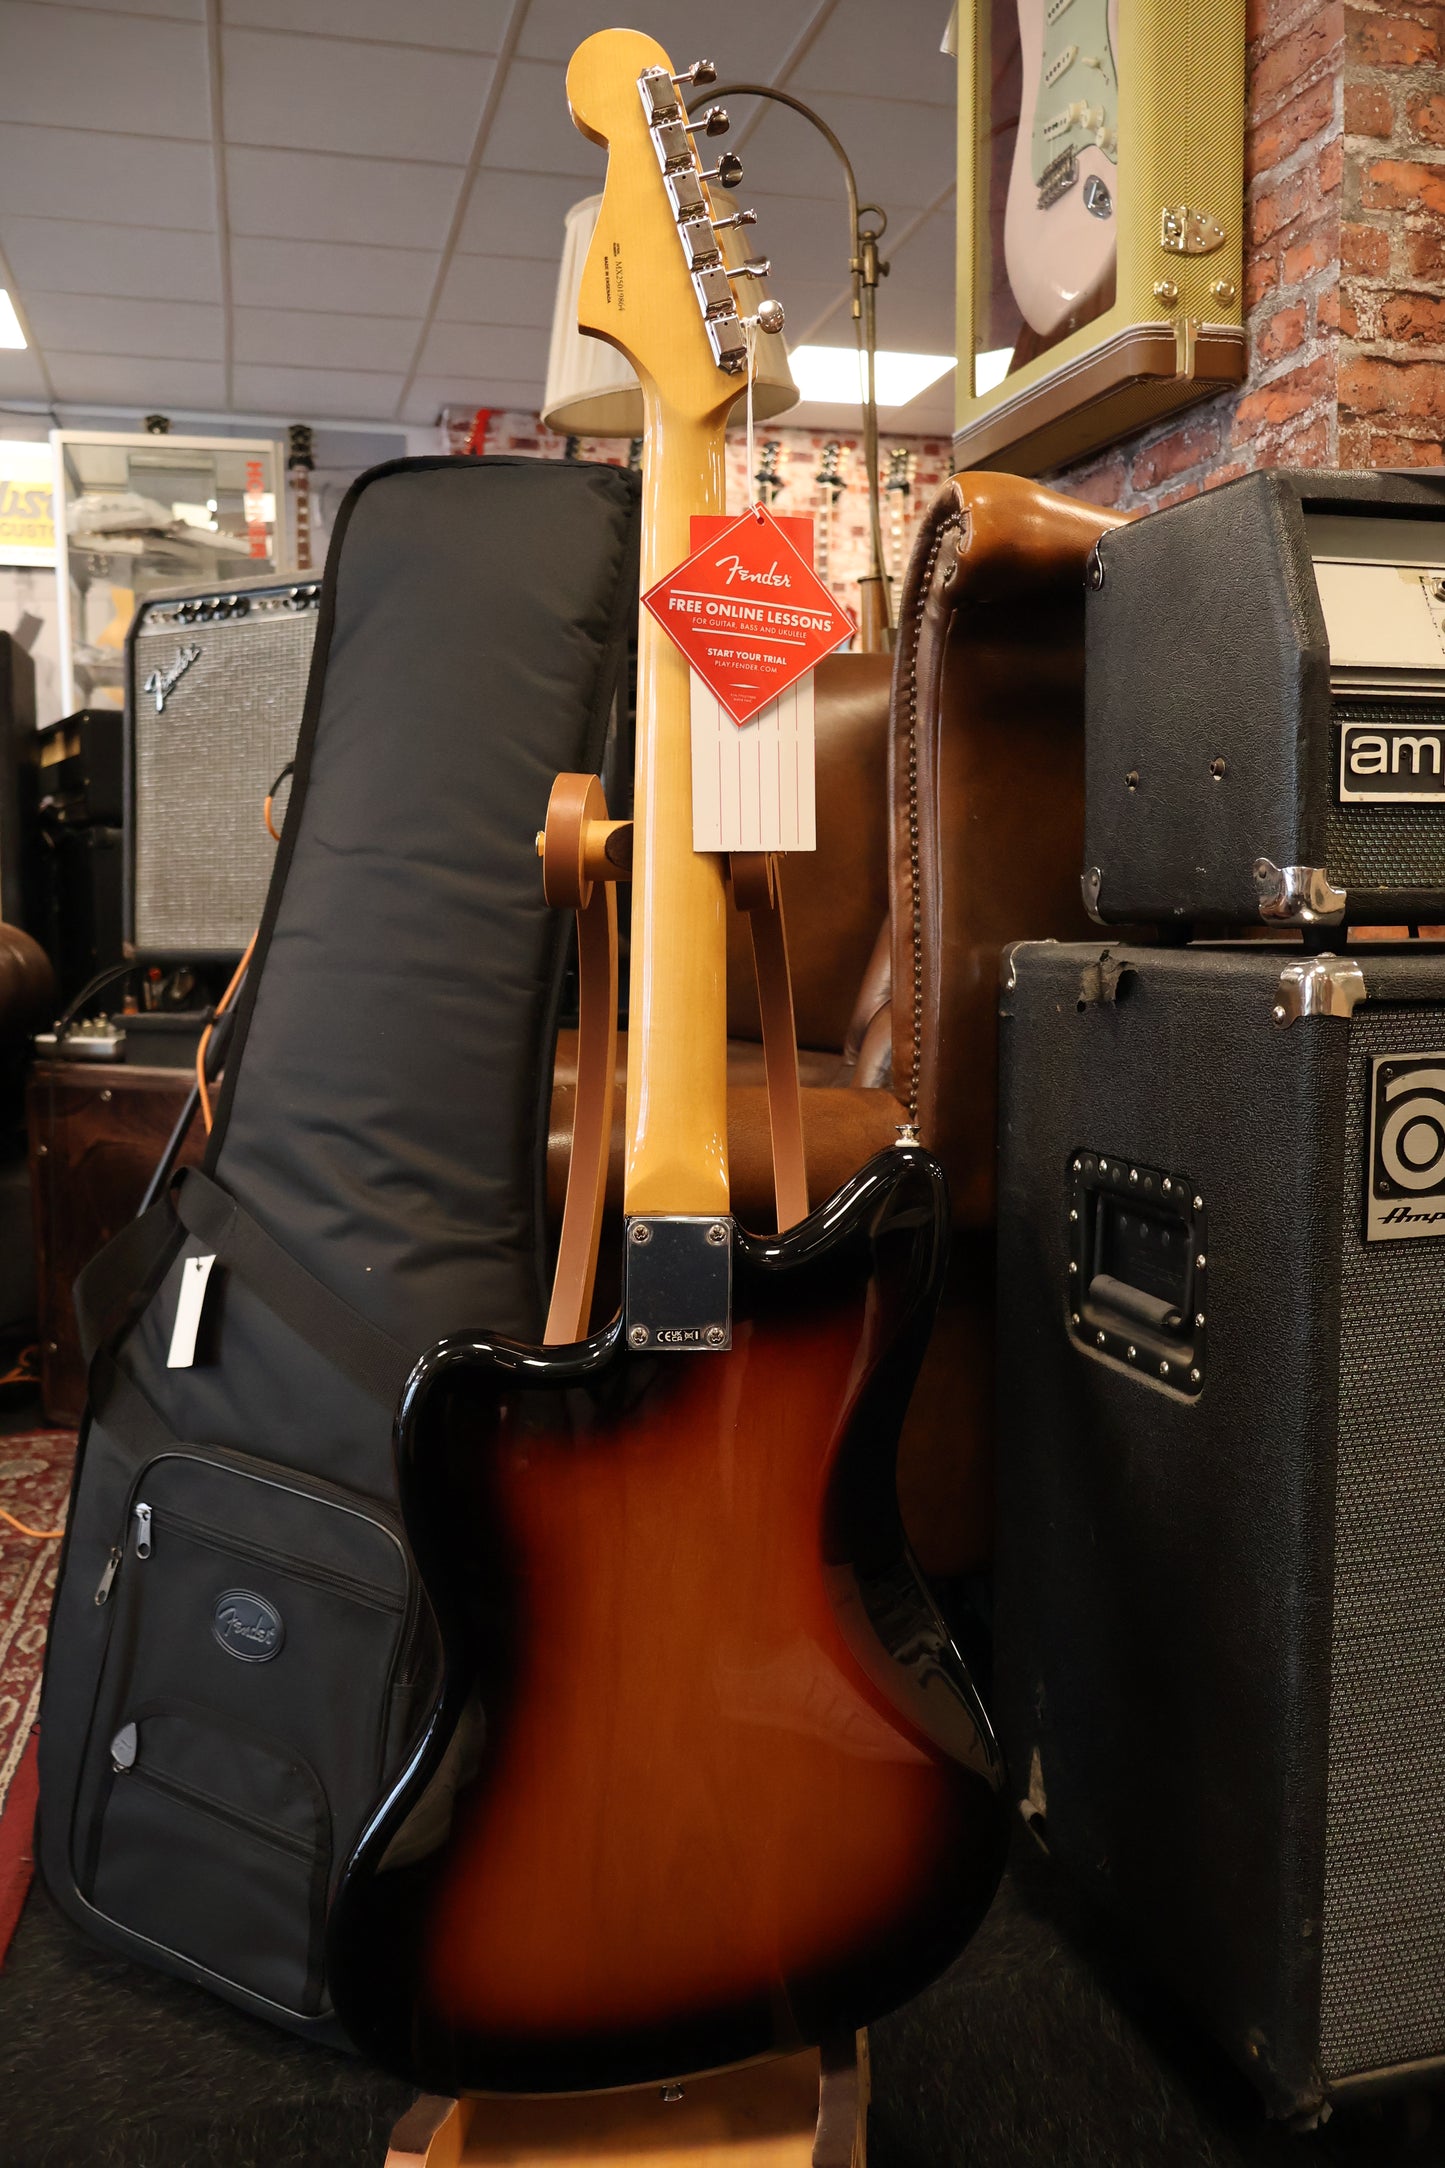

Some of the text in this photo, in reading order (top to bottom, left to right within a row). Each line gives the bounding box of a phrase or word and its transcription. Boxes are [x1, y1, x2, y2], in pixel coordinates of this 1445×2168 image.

[715, 555, 792, 588] Fender
[668, 597, 833, 632] FREE ONLINE LESSONS
[692, 617, 807, 639] FOR GUITAR, BASS AND UKULELE
[707, 647, 787, 665] START YOUR TRIAL
[714, 660, 778, 673] PLAY.FENDER.COM
[143, 645, 201, 713] Fender
[1350, 735, 1445, 786] am
[219, 1606, 276, 1645] Fender
